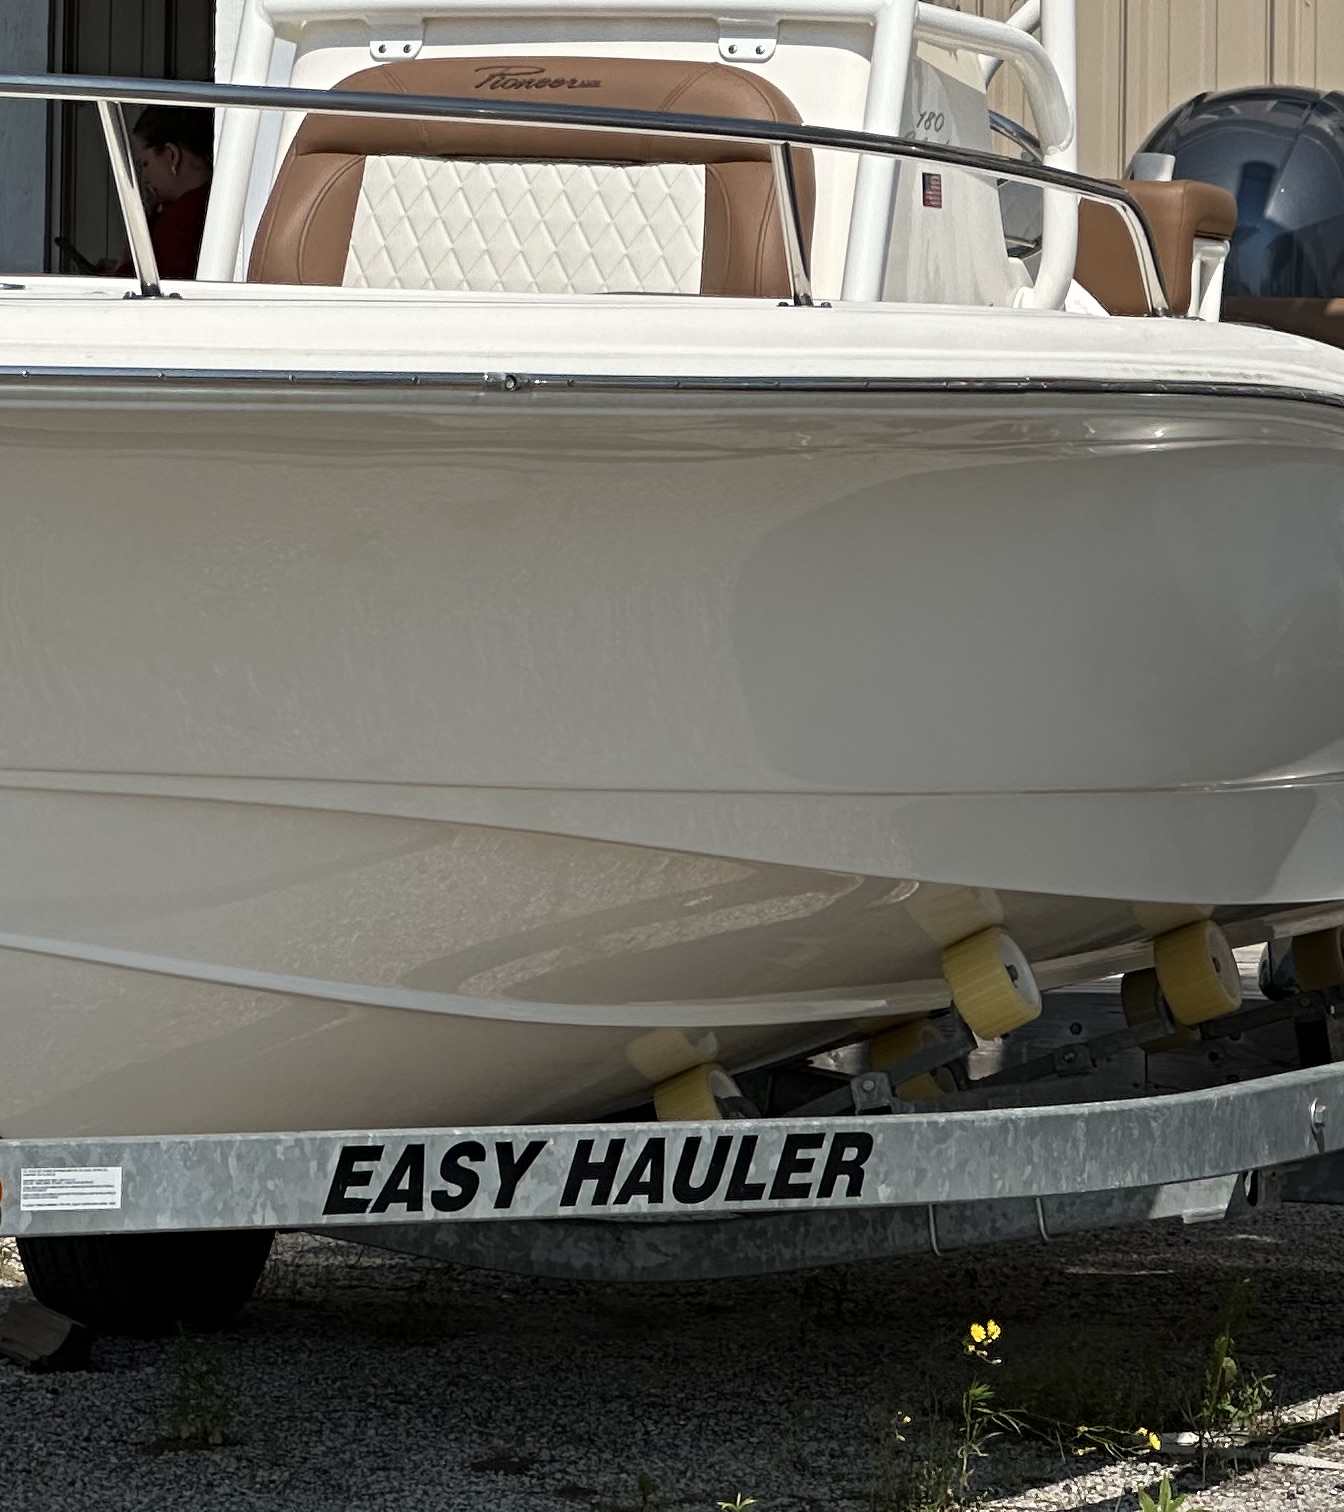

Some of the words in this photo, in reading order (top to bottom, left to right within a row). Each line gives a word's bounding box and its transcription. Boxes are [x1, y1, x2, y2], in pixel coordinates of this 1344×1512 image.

[474, 65, 578, 90] Pioneer
[916, 111, 945, 132] 180
[322, 1140, 547, 1216] EASY
[559, 1131, 874, 1206] HAULER
